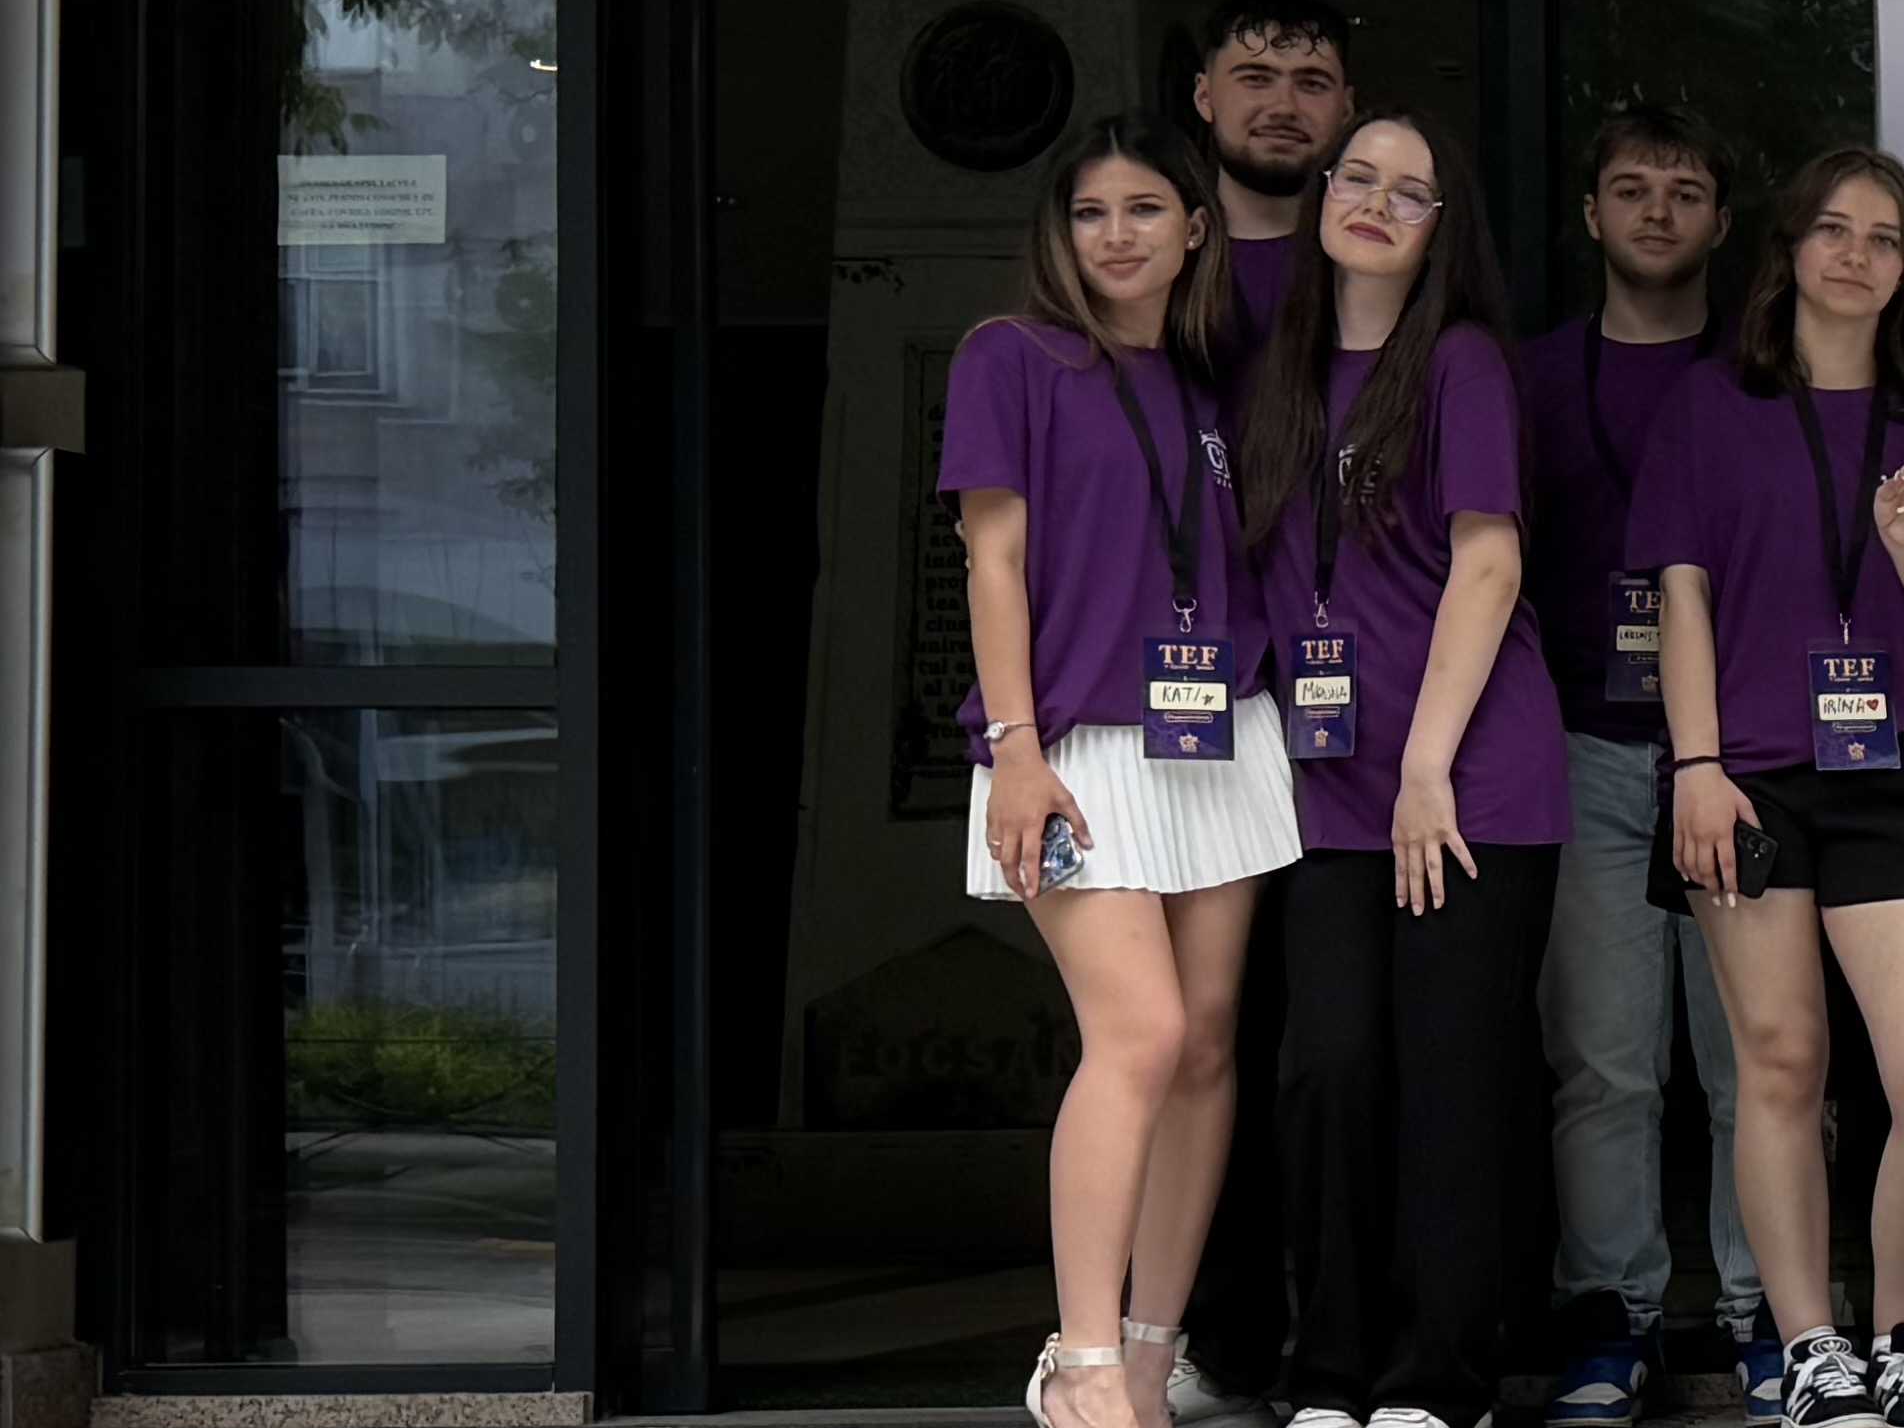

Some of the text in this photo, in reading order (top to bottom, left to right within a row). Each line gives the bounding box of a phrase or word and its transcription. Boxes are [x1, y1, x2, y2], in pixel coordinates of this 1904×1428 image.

[1158, 644, 1219, 665] TEF
[1301, 638, 1345, 659] TEF
[1822, 658, 1877, 677] TEF
